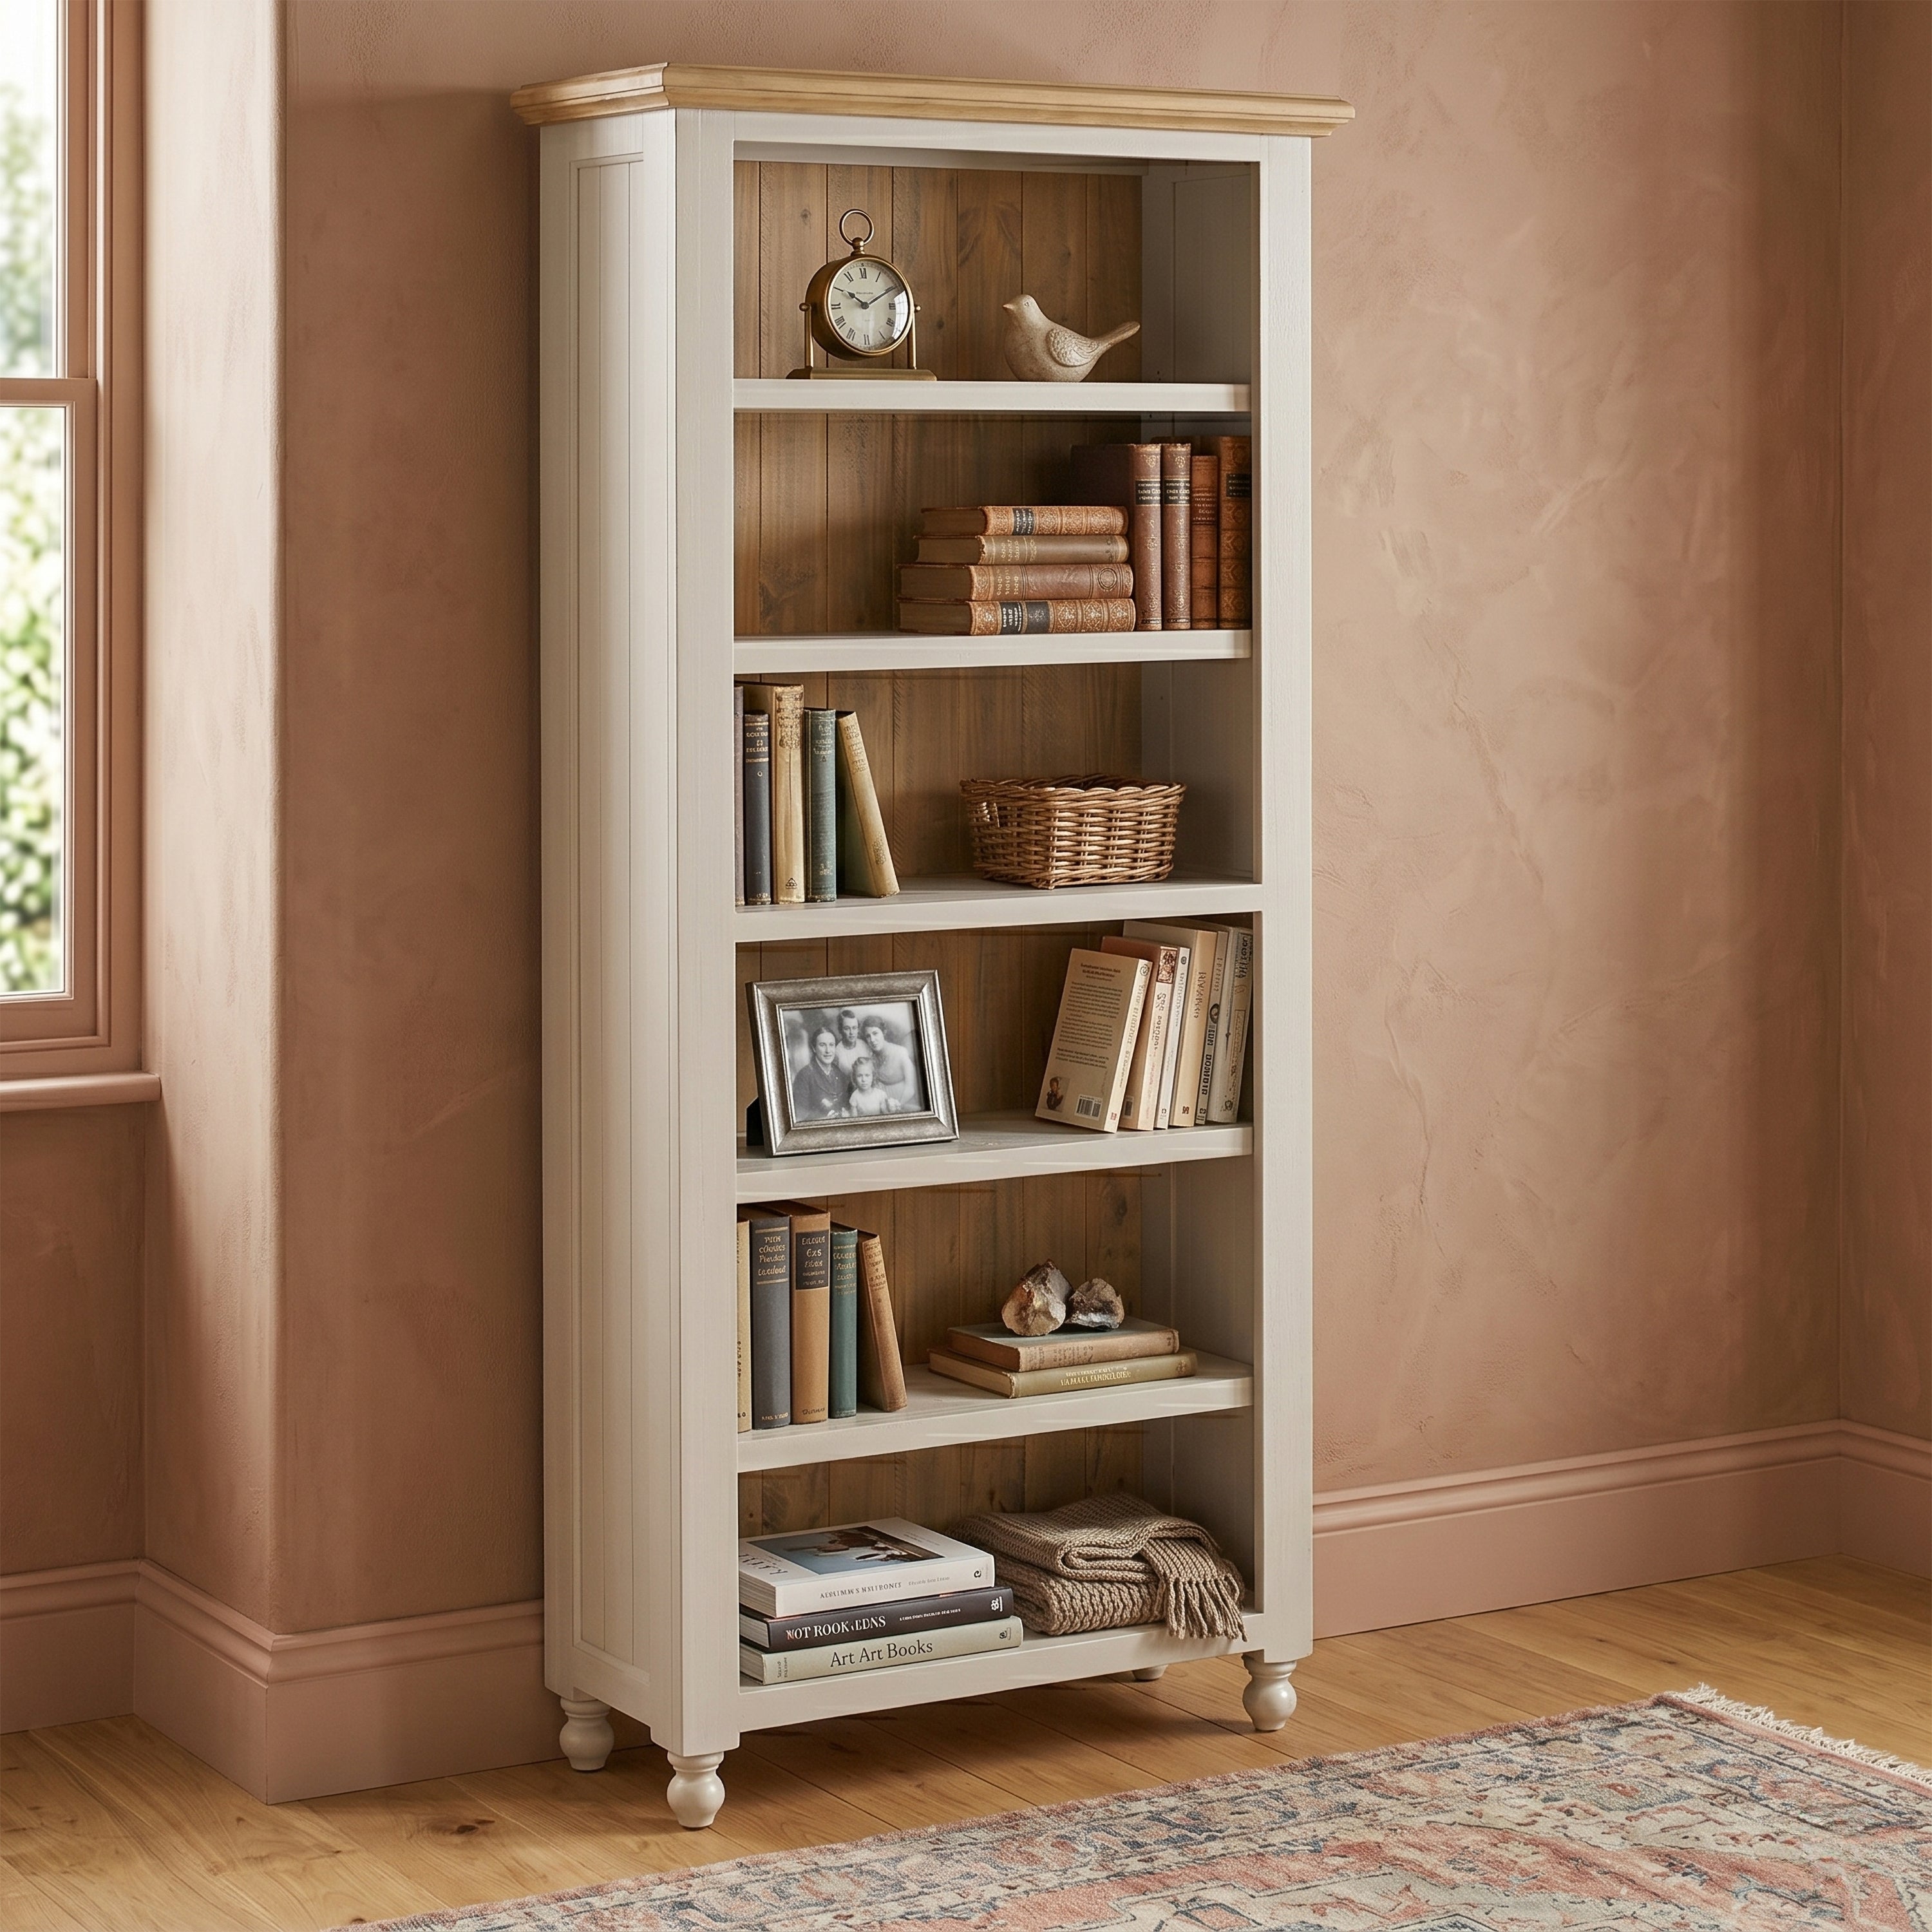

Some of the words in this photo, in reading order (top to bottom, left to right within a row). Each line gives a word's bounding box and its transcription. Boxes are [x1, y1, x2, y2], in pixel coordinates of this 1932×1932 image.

[830, 1651, 855, 1667] Art
[859, 1647, 883, 1663] Art
[886, 1639, 933, 1659] Books
